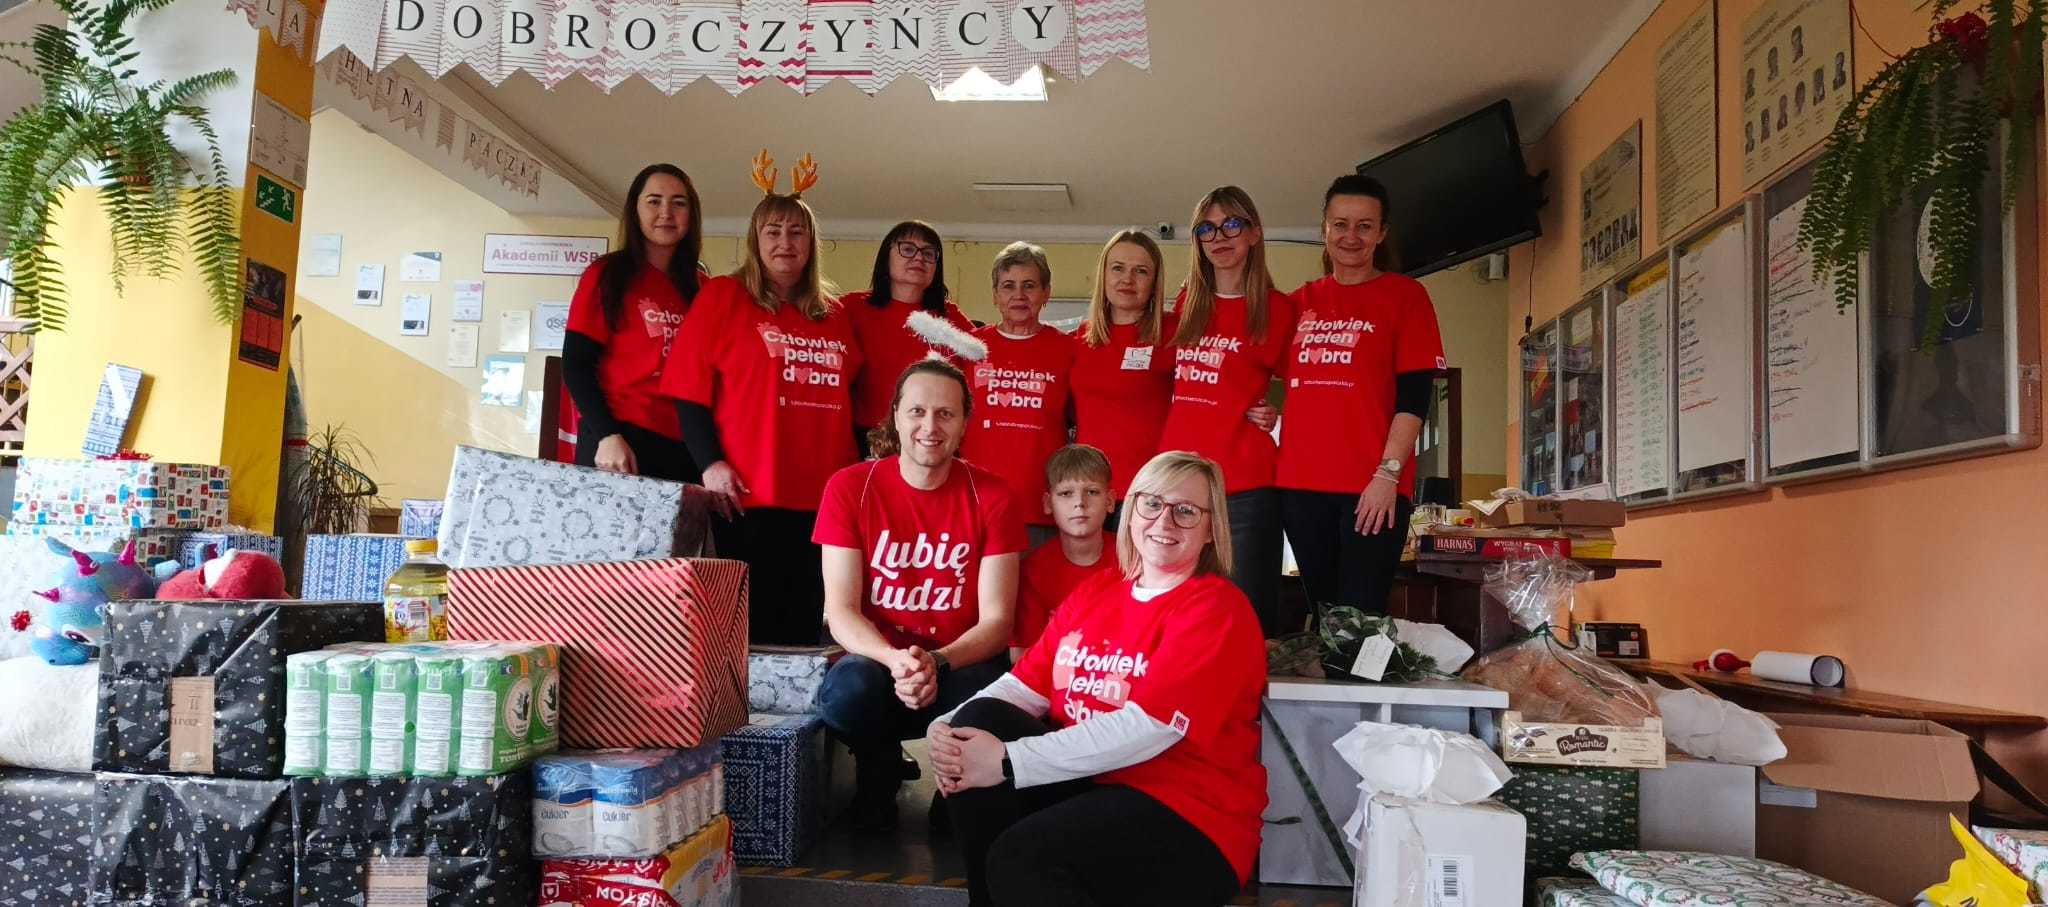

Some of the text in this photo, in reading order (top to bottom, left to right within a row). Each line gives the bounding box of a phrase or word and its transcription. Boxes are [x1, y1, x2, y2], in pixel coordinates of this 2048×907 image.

[395, 0, 1055, 53] DOBROCZYŃCY
[492, 249, 559, 262] Akademii
[870, 529, 970, 579] Lubię
